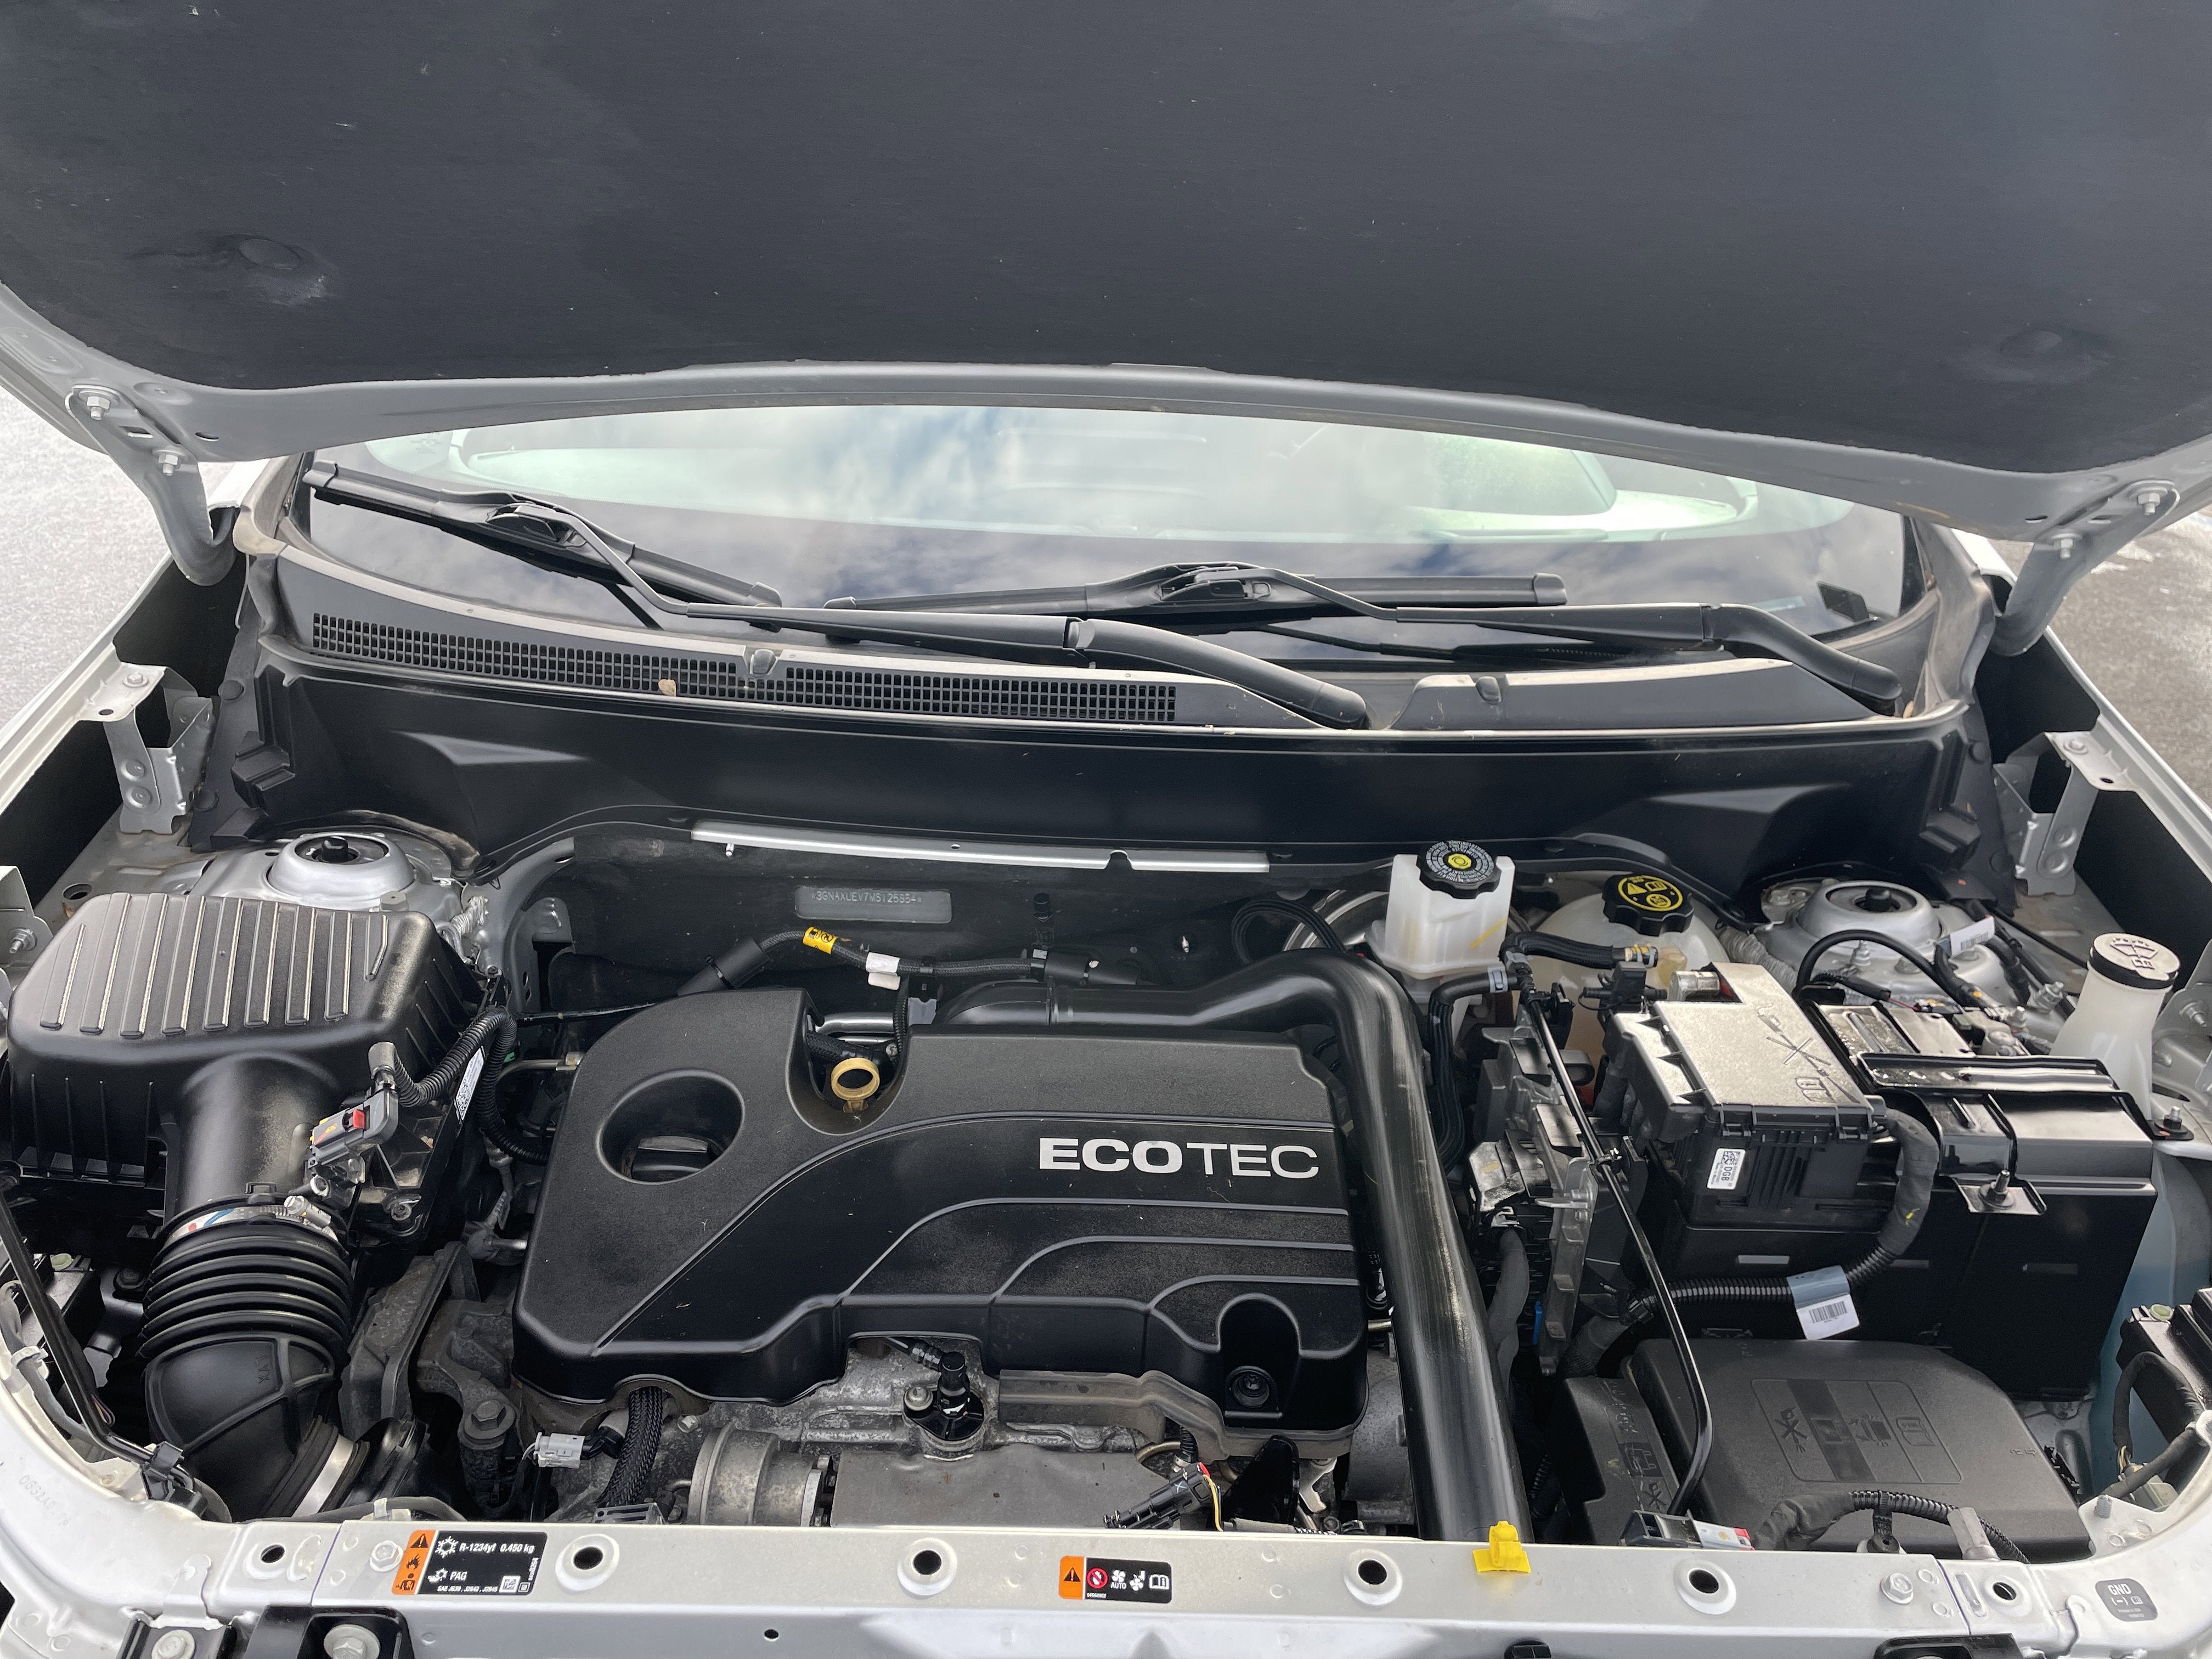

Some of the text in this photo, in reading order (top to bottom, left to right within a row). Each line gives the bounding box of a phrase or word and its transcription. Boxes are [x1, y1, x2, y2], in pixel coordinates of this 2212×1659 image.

[1039, 1137, 1319, 1179] ECOTEC
[1721, 1166, 1733, 1181] DGB
[459, 1543, 535, 1554] R-1234yf 0.450 kg
[449, 1571, 467, 1581] PAG
[1110, 1582, 1127, 1590] AUTO
[2107, 1583, 2131, 1595] GND
